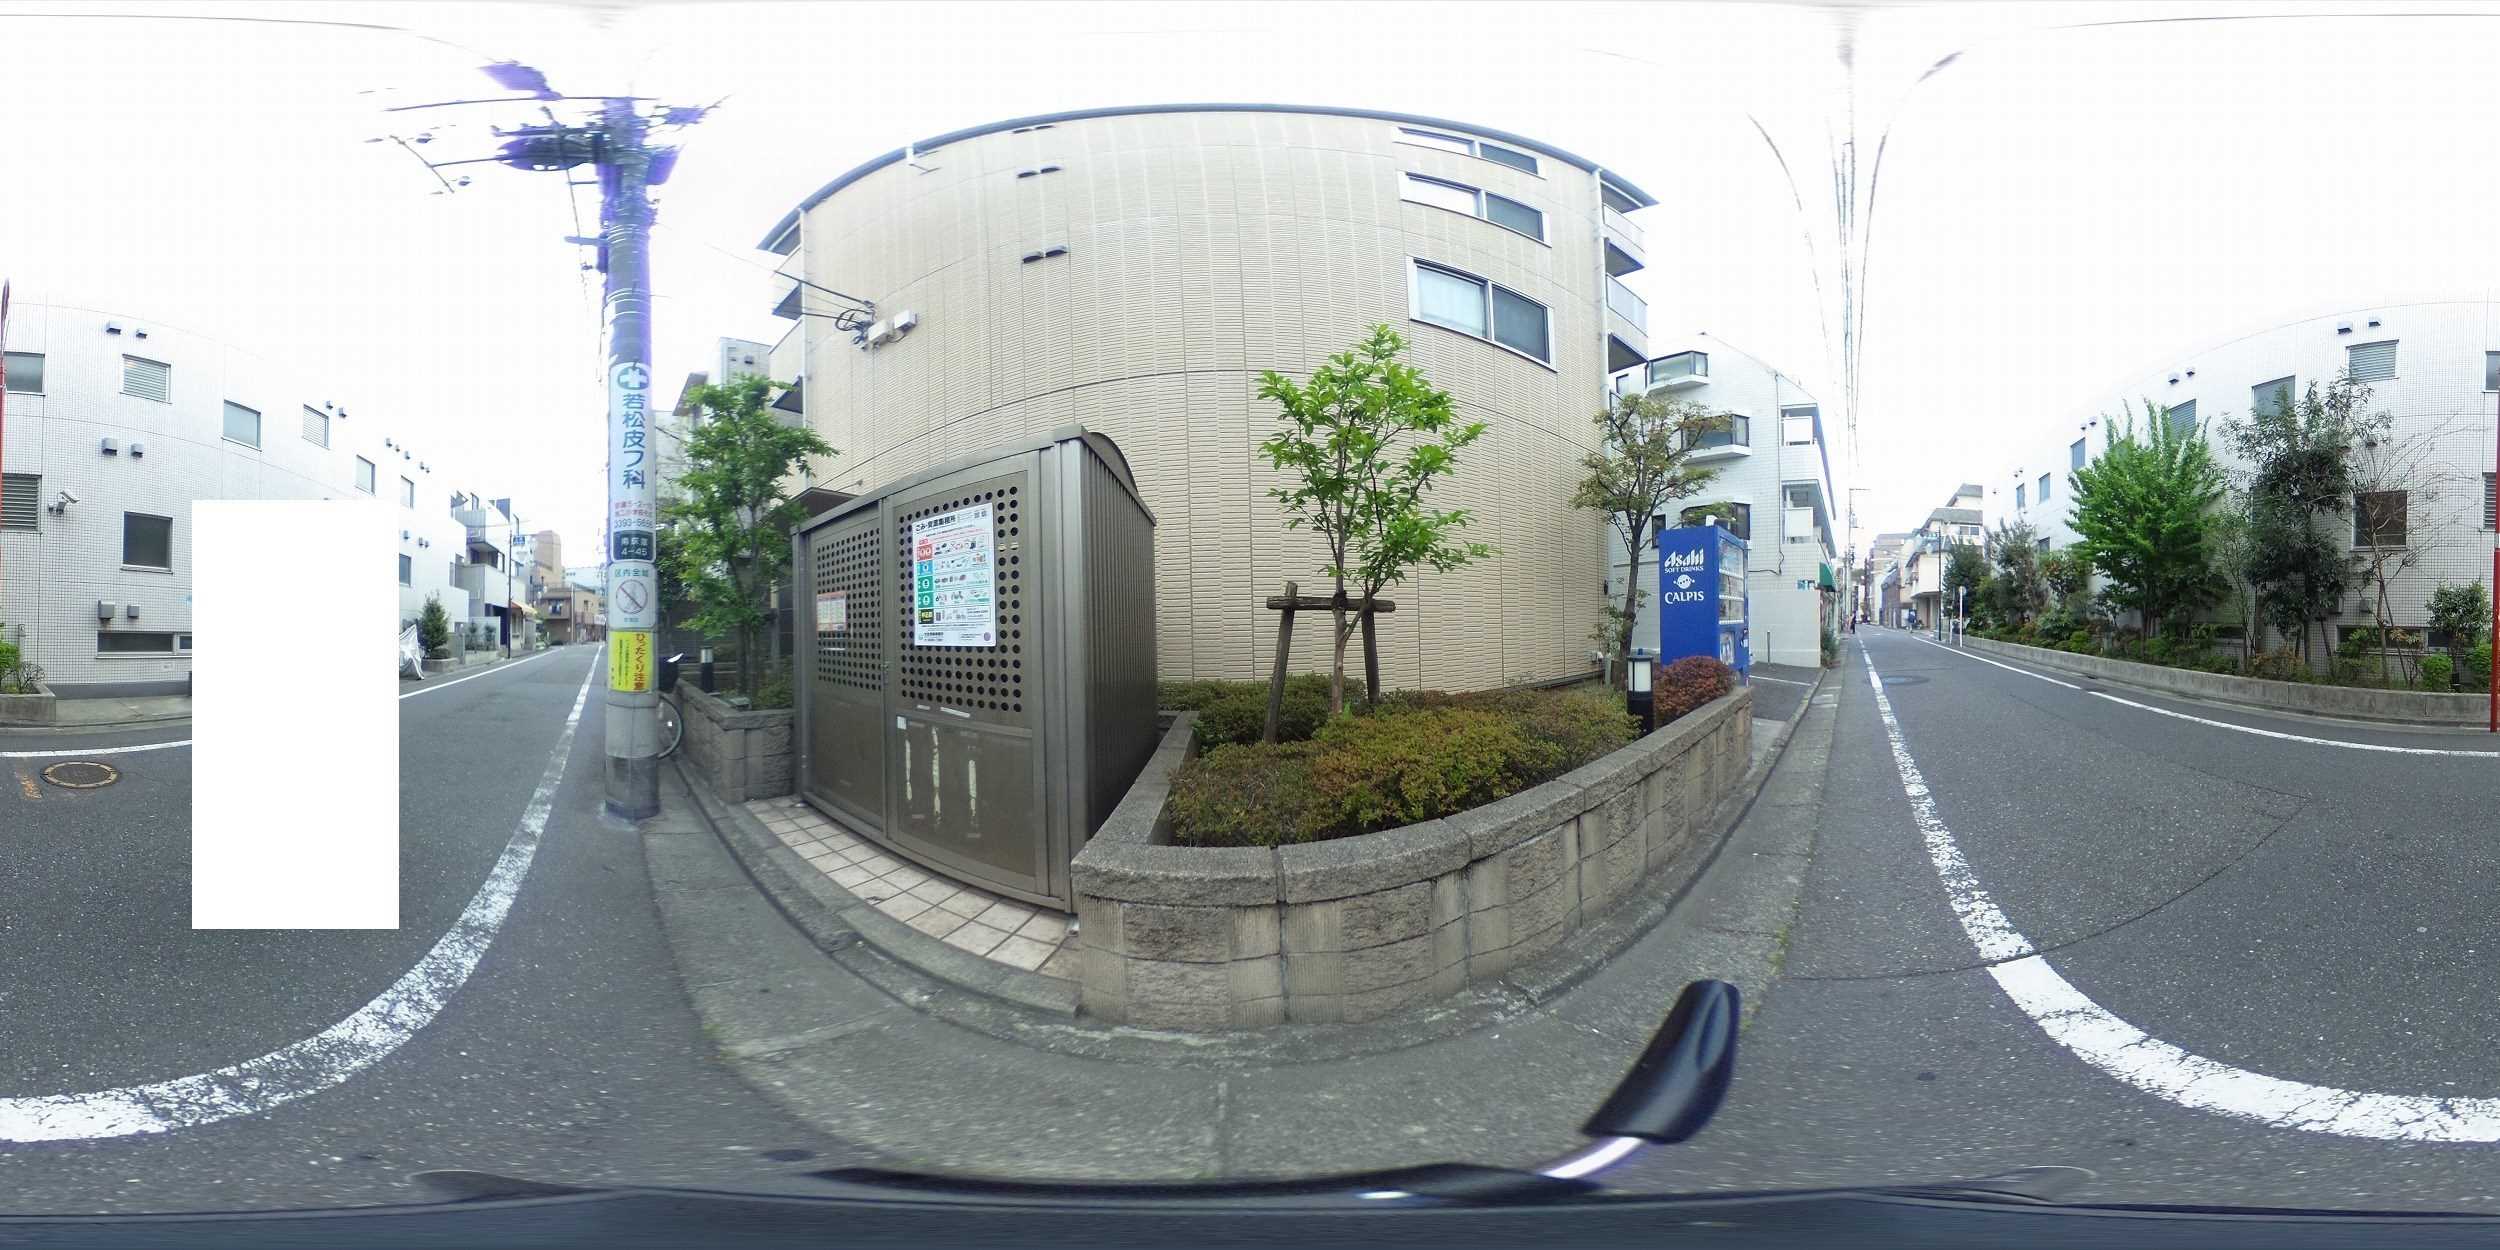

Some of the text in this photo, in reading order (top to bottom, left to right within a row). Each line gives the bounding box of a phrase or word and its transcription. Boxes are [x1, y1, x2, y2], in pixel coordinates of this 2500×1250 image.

[623, 393, 645, 489] 若松皮フ科
[1664, 548, 1704, 567] Asahi
[1664, 566, 1679, 574] SOFT
[1664, 591, 1704, 605] CALPIS
